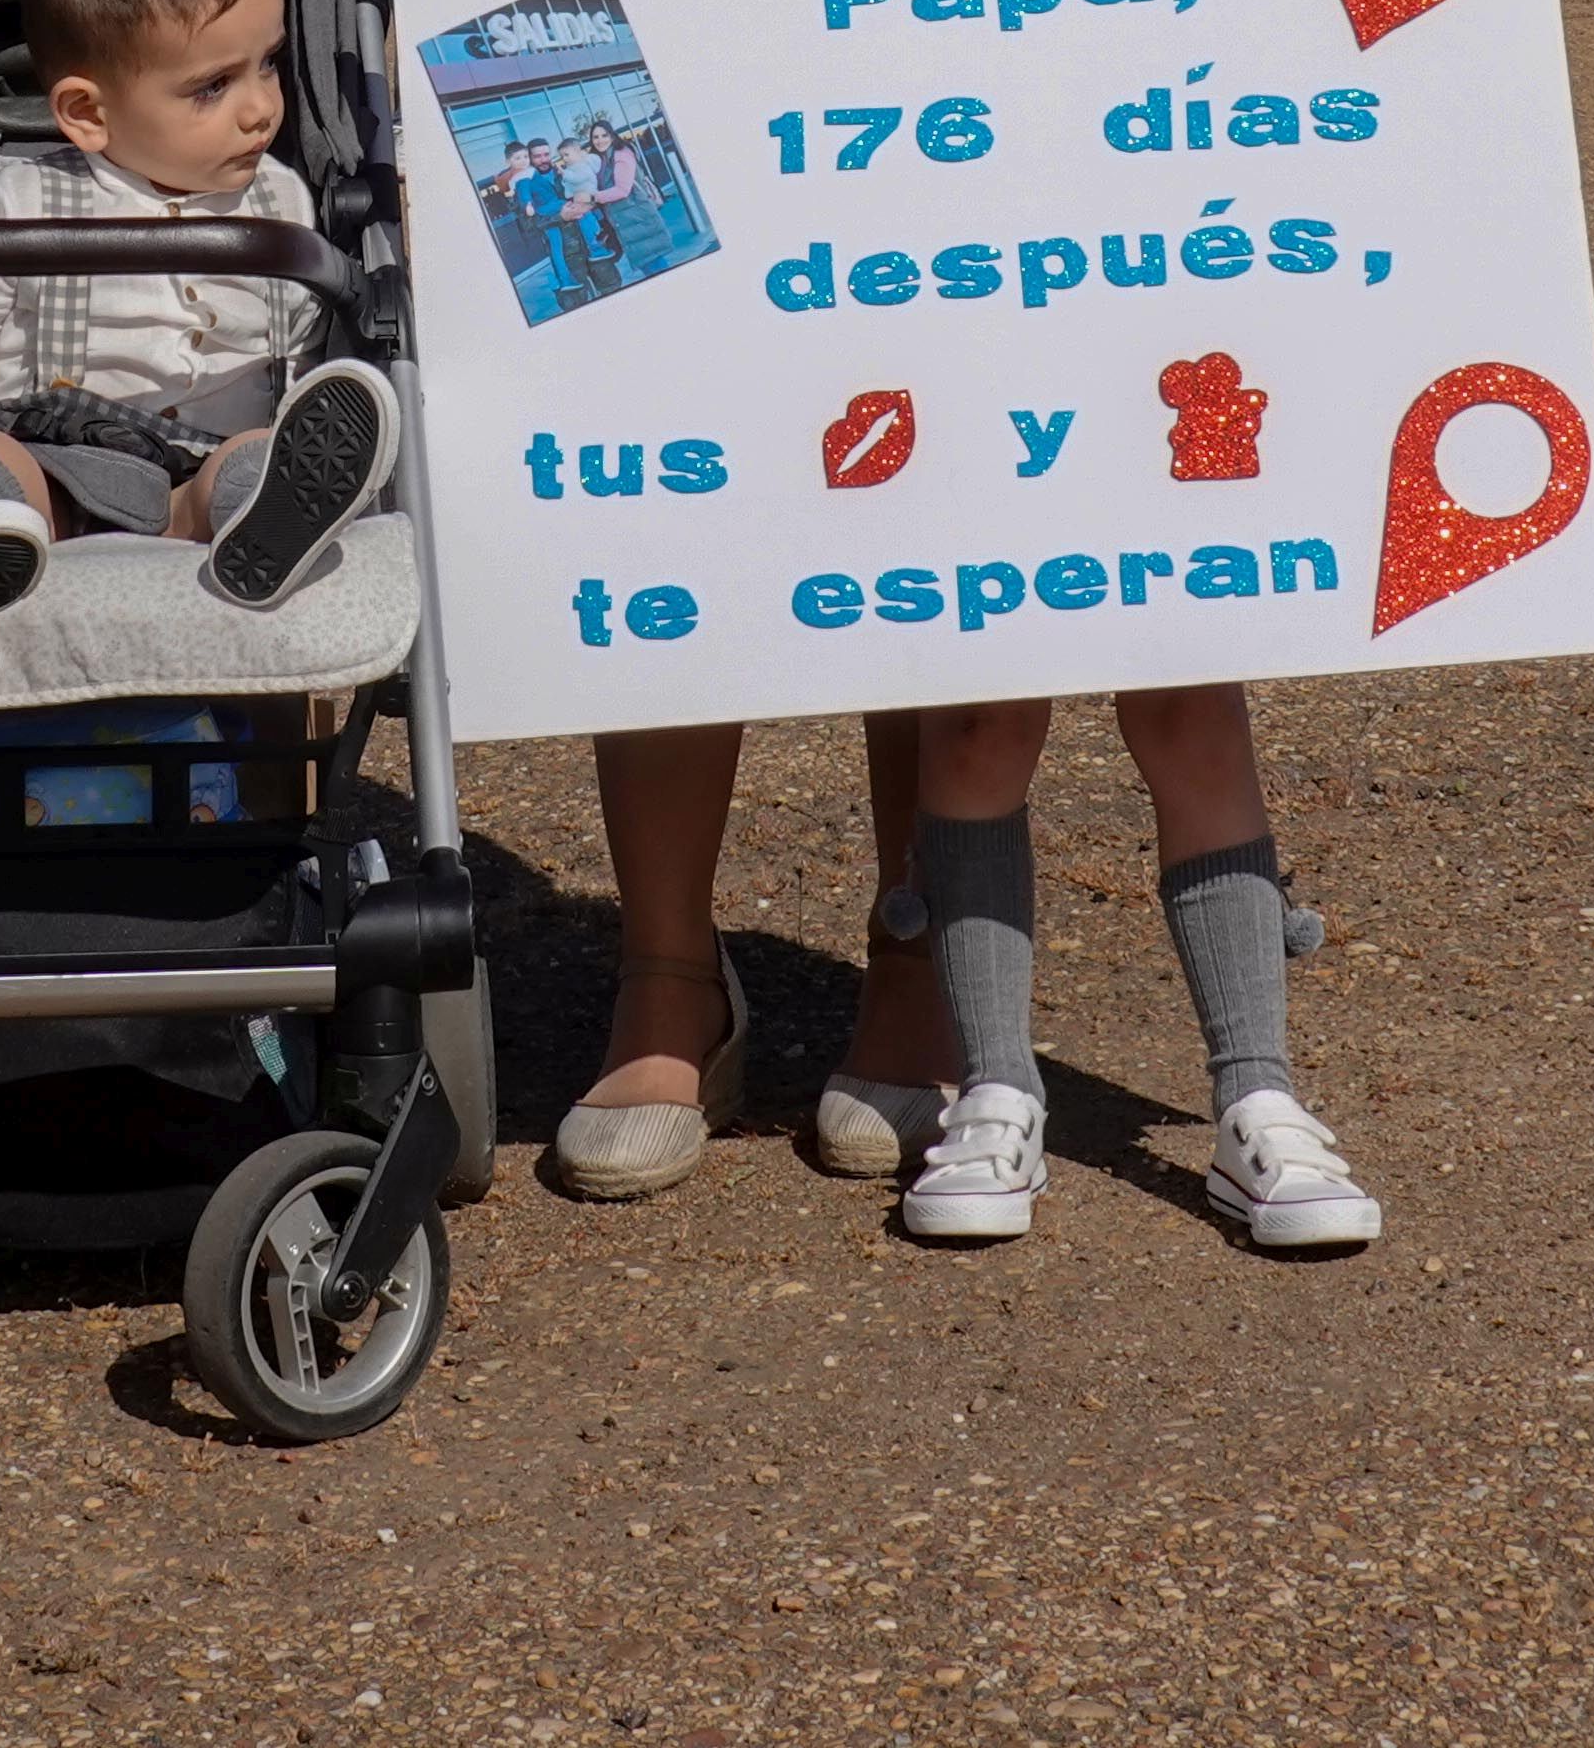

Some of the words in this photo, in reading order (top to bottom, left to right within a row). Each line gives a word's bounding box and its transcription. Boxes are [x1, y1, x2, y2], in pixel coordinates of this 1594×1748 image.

[487, 10, 615, 55] SALIDAS
[769, 96, 996, 173] 176
[1103, 63, 1380, 152] días
[765, 198, 1393, 312] después,
[525, 432, 729, 499] tus
[1009, 410, 1076, 476] y
[572, 578, 699, 646] te
[791, 538, 1339, 631] esperan
